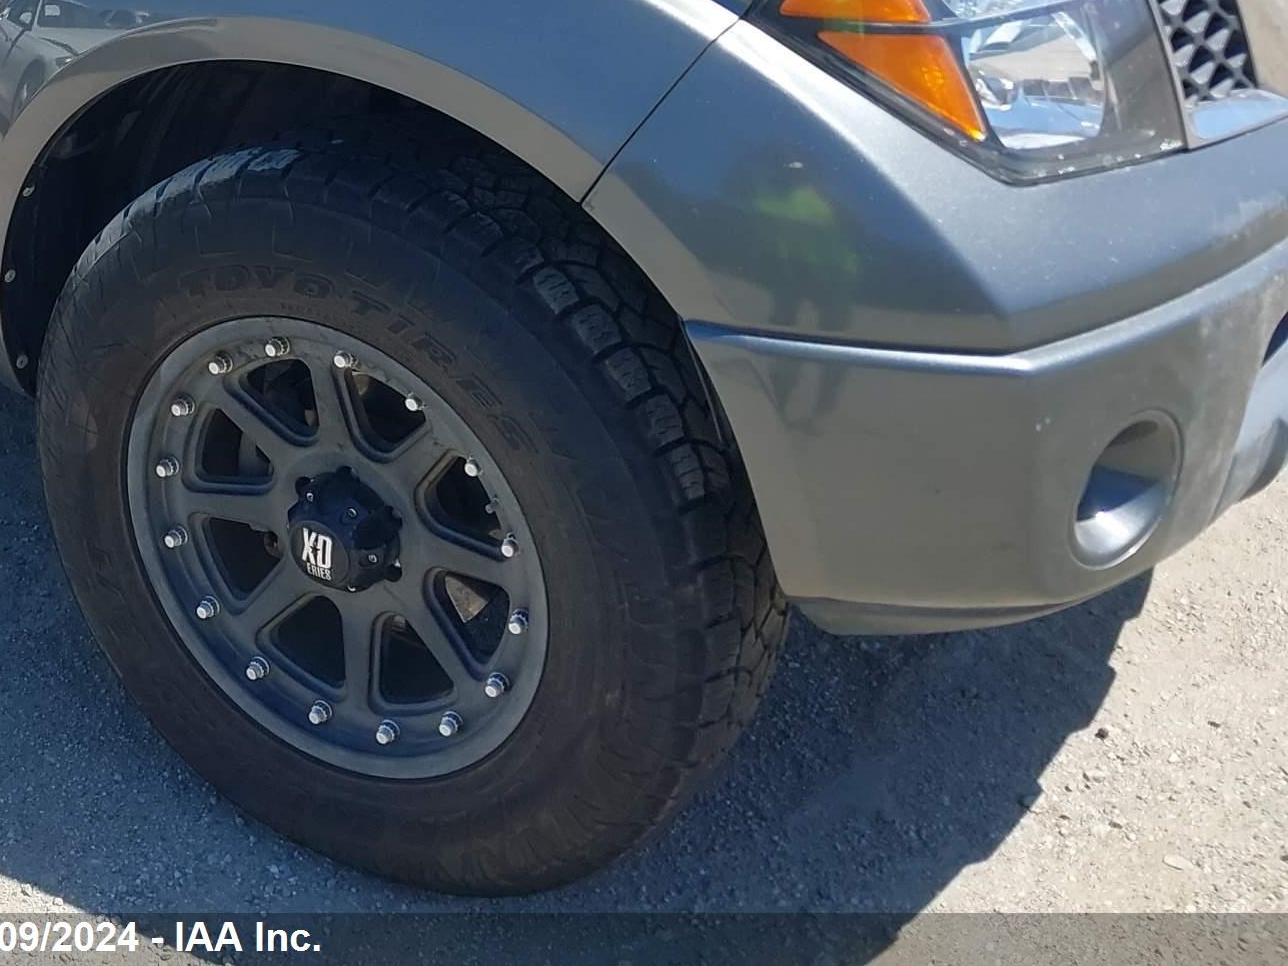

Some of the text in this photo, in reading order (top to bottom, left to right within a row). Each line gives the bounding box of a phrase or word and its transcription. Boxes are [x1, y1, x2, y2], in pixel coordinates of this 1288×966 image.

[178, 263, 538, 454] TOYO TIRES
[301, 527, 333, 569] XD
